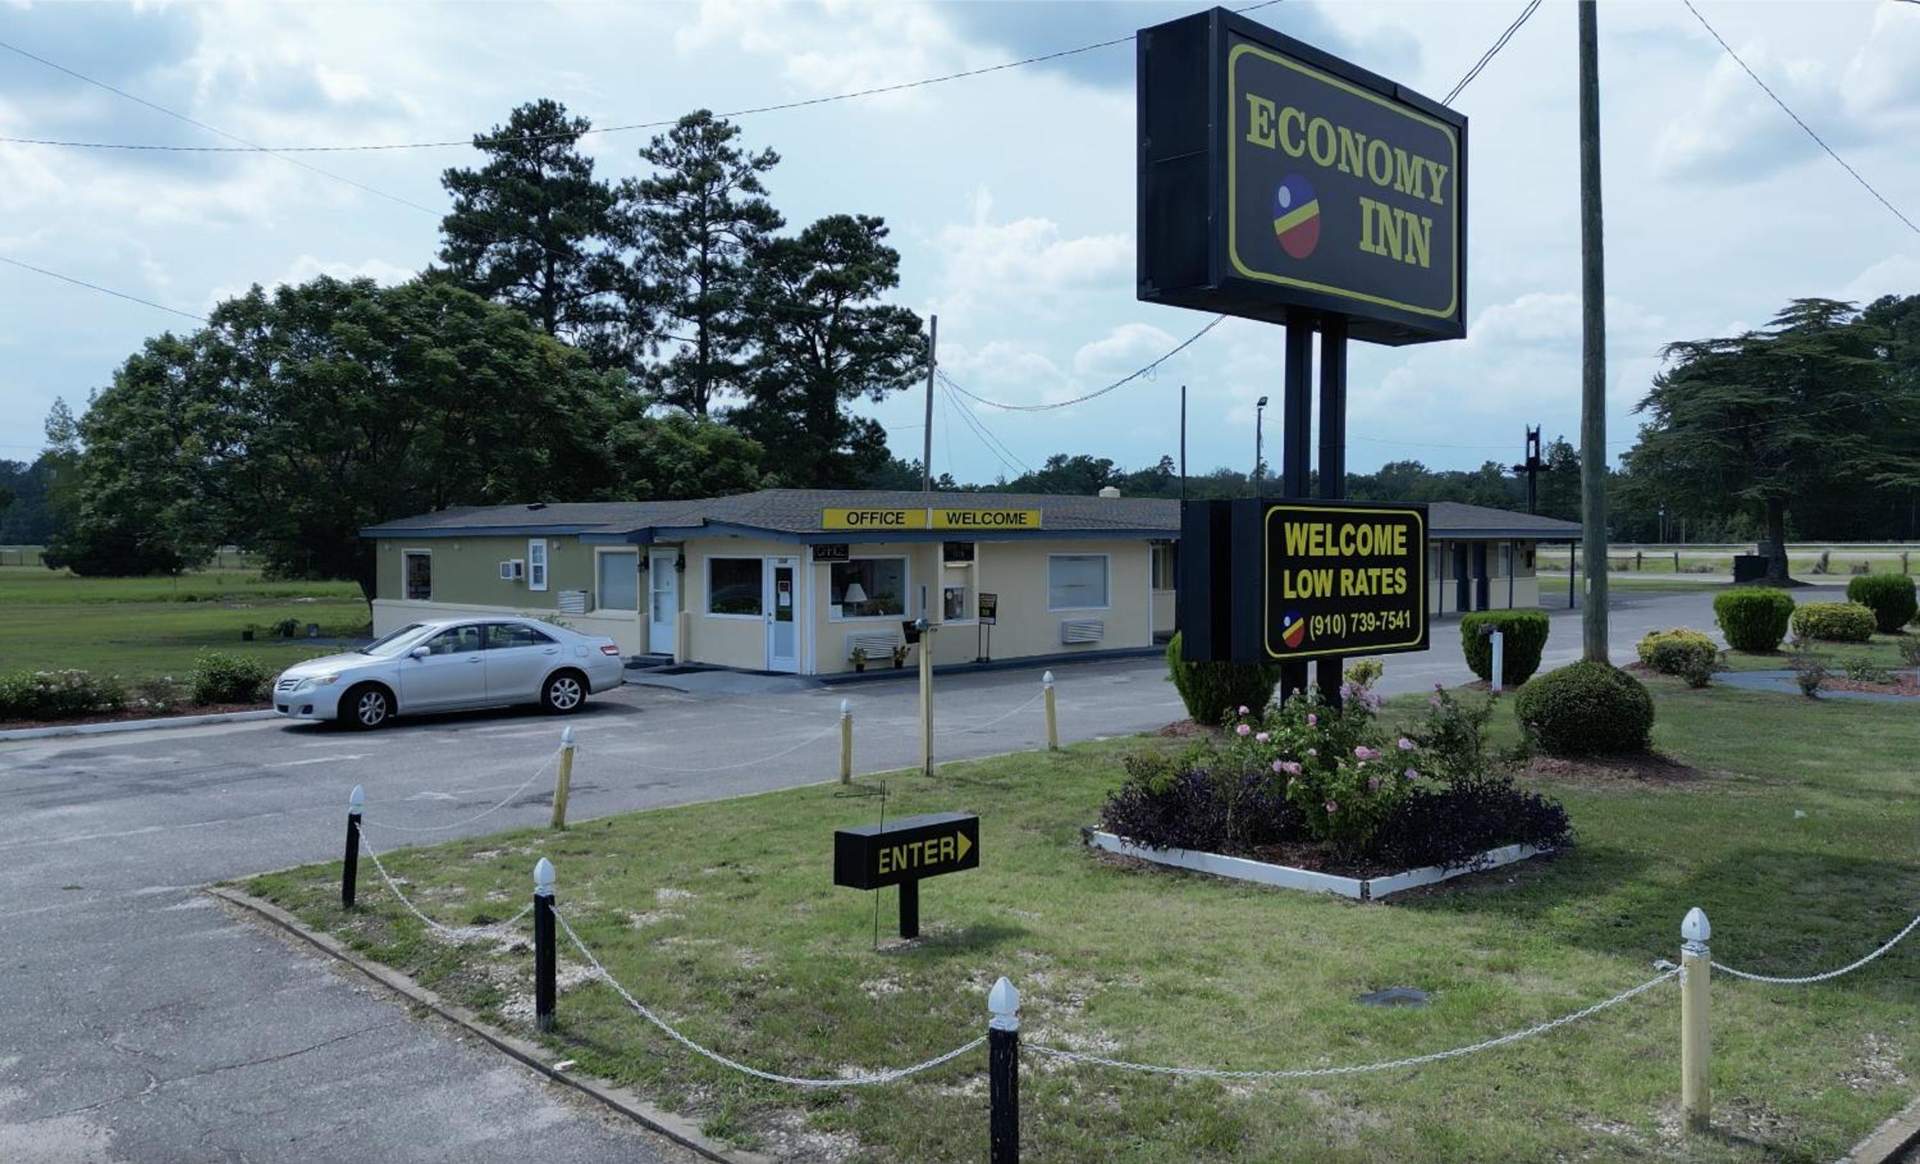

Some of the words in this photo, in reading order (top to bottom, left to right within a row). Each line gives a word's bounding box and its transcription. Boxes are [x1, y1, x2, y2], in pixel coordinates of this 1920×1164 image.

[1246, 93, 1448, 205] ECONOMY
[1359, 196, 1433, 269] INN
[847, 511, 905, 525] OFFICE
[946, 512, 1027, 525] WELCOME
[1284, 522, 1408, 556] WELCOME
[1283, 569, 1334, 599] LOW
[1340, 567, 1407, 596] RATES
[1309, 614, 1347, 640] (910)
[1351, 610, 1411, 633] 739-7541
[878, 836, 954, 874] ENTER
